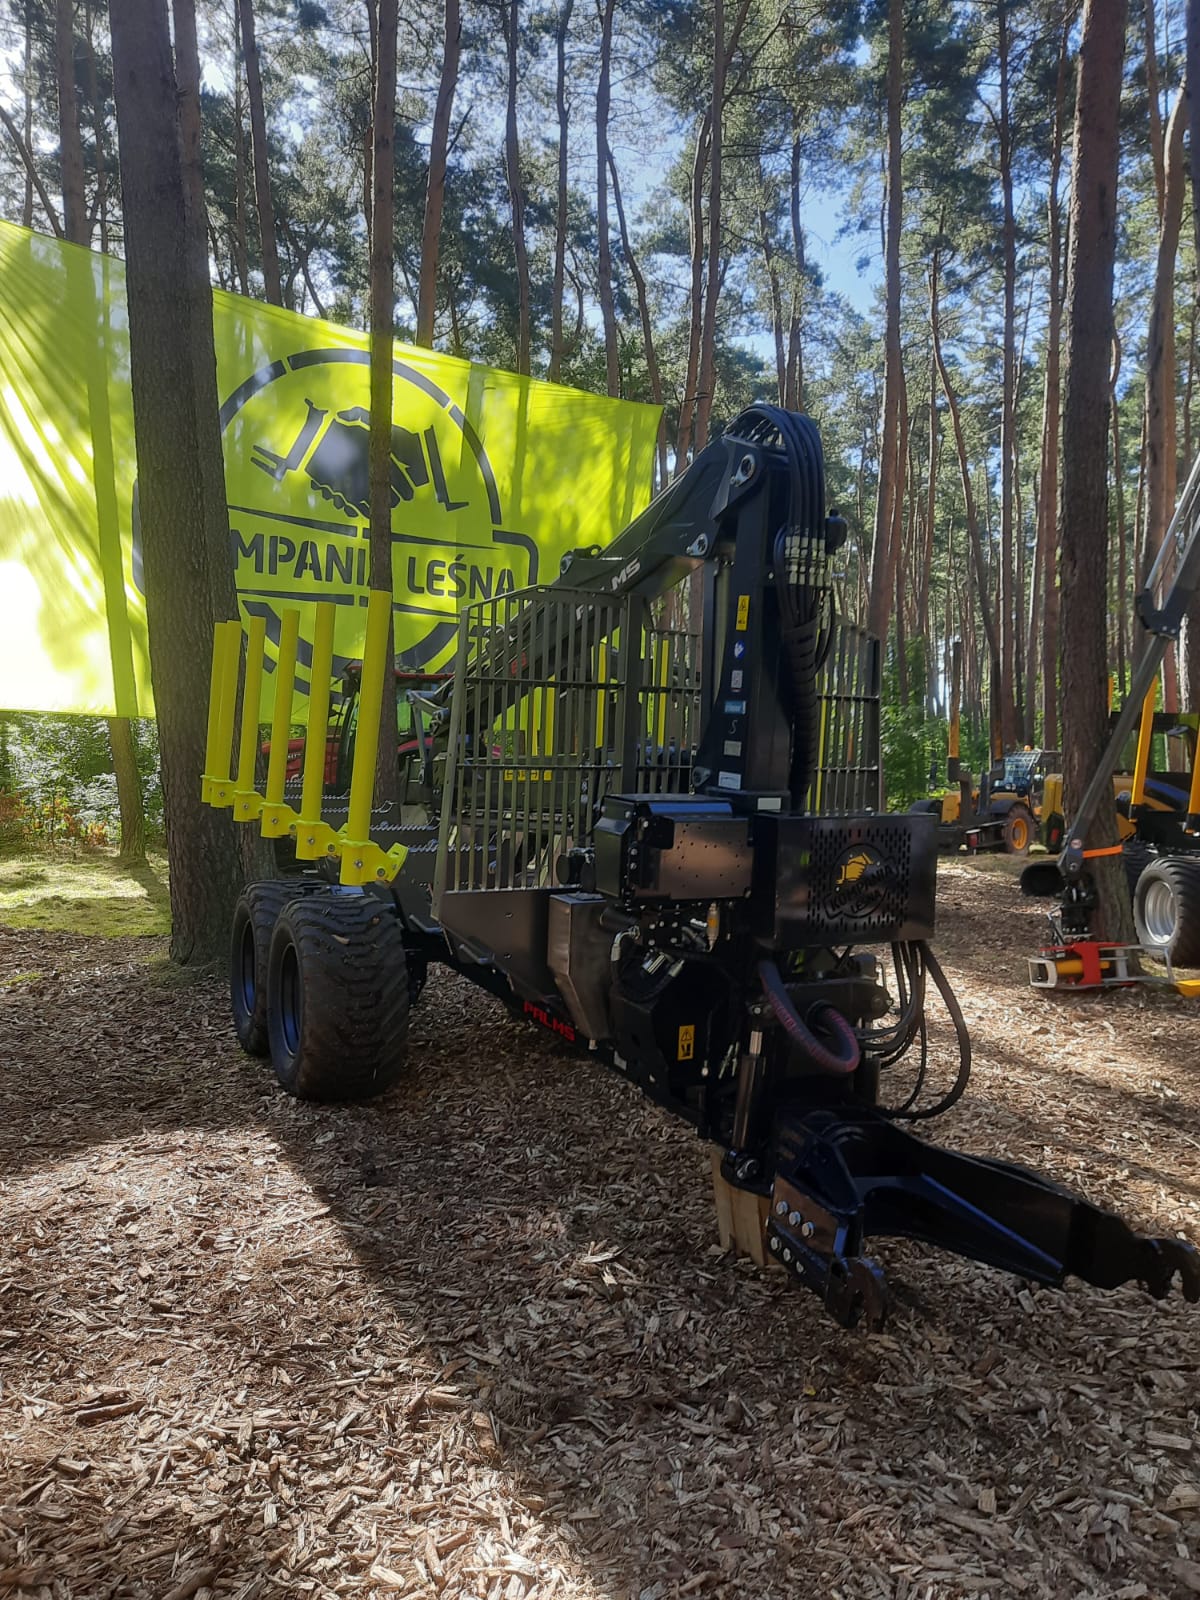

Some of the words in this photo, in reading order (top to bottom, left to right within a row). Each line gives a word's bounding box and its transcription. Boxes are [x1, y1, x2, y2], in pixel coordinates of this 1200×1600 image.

[230, 529, 371, 586] MPANI
[407, 553, 517, 604] LEŚNA
[523, 1000, 576, 1041] PALMS
